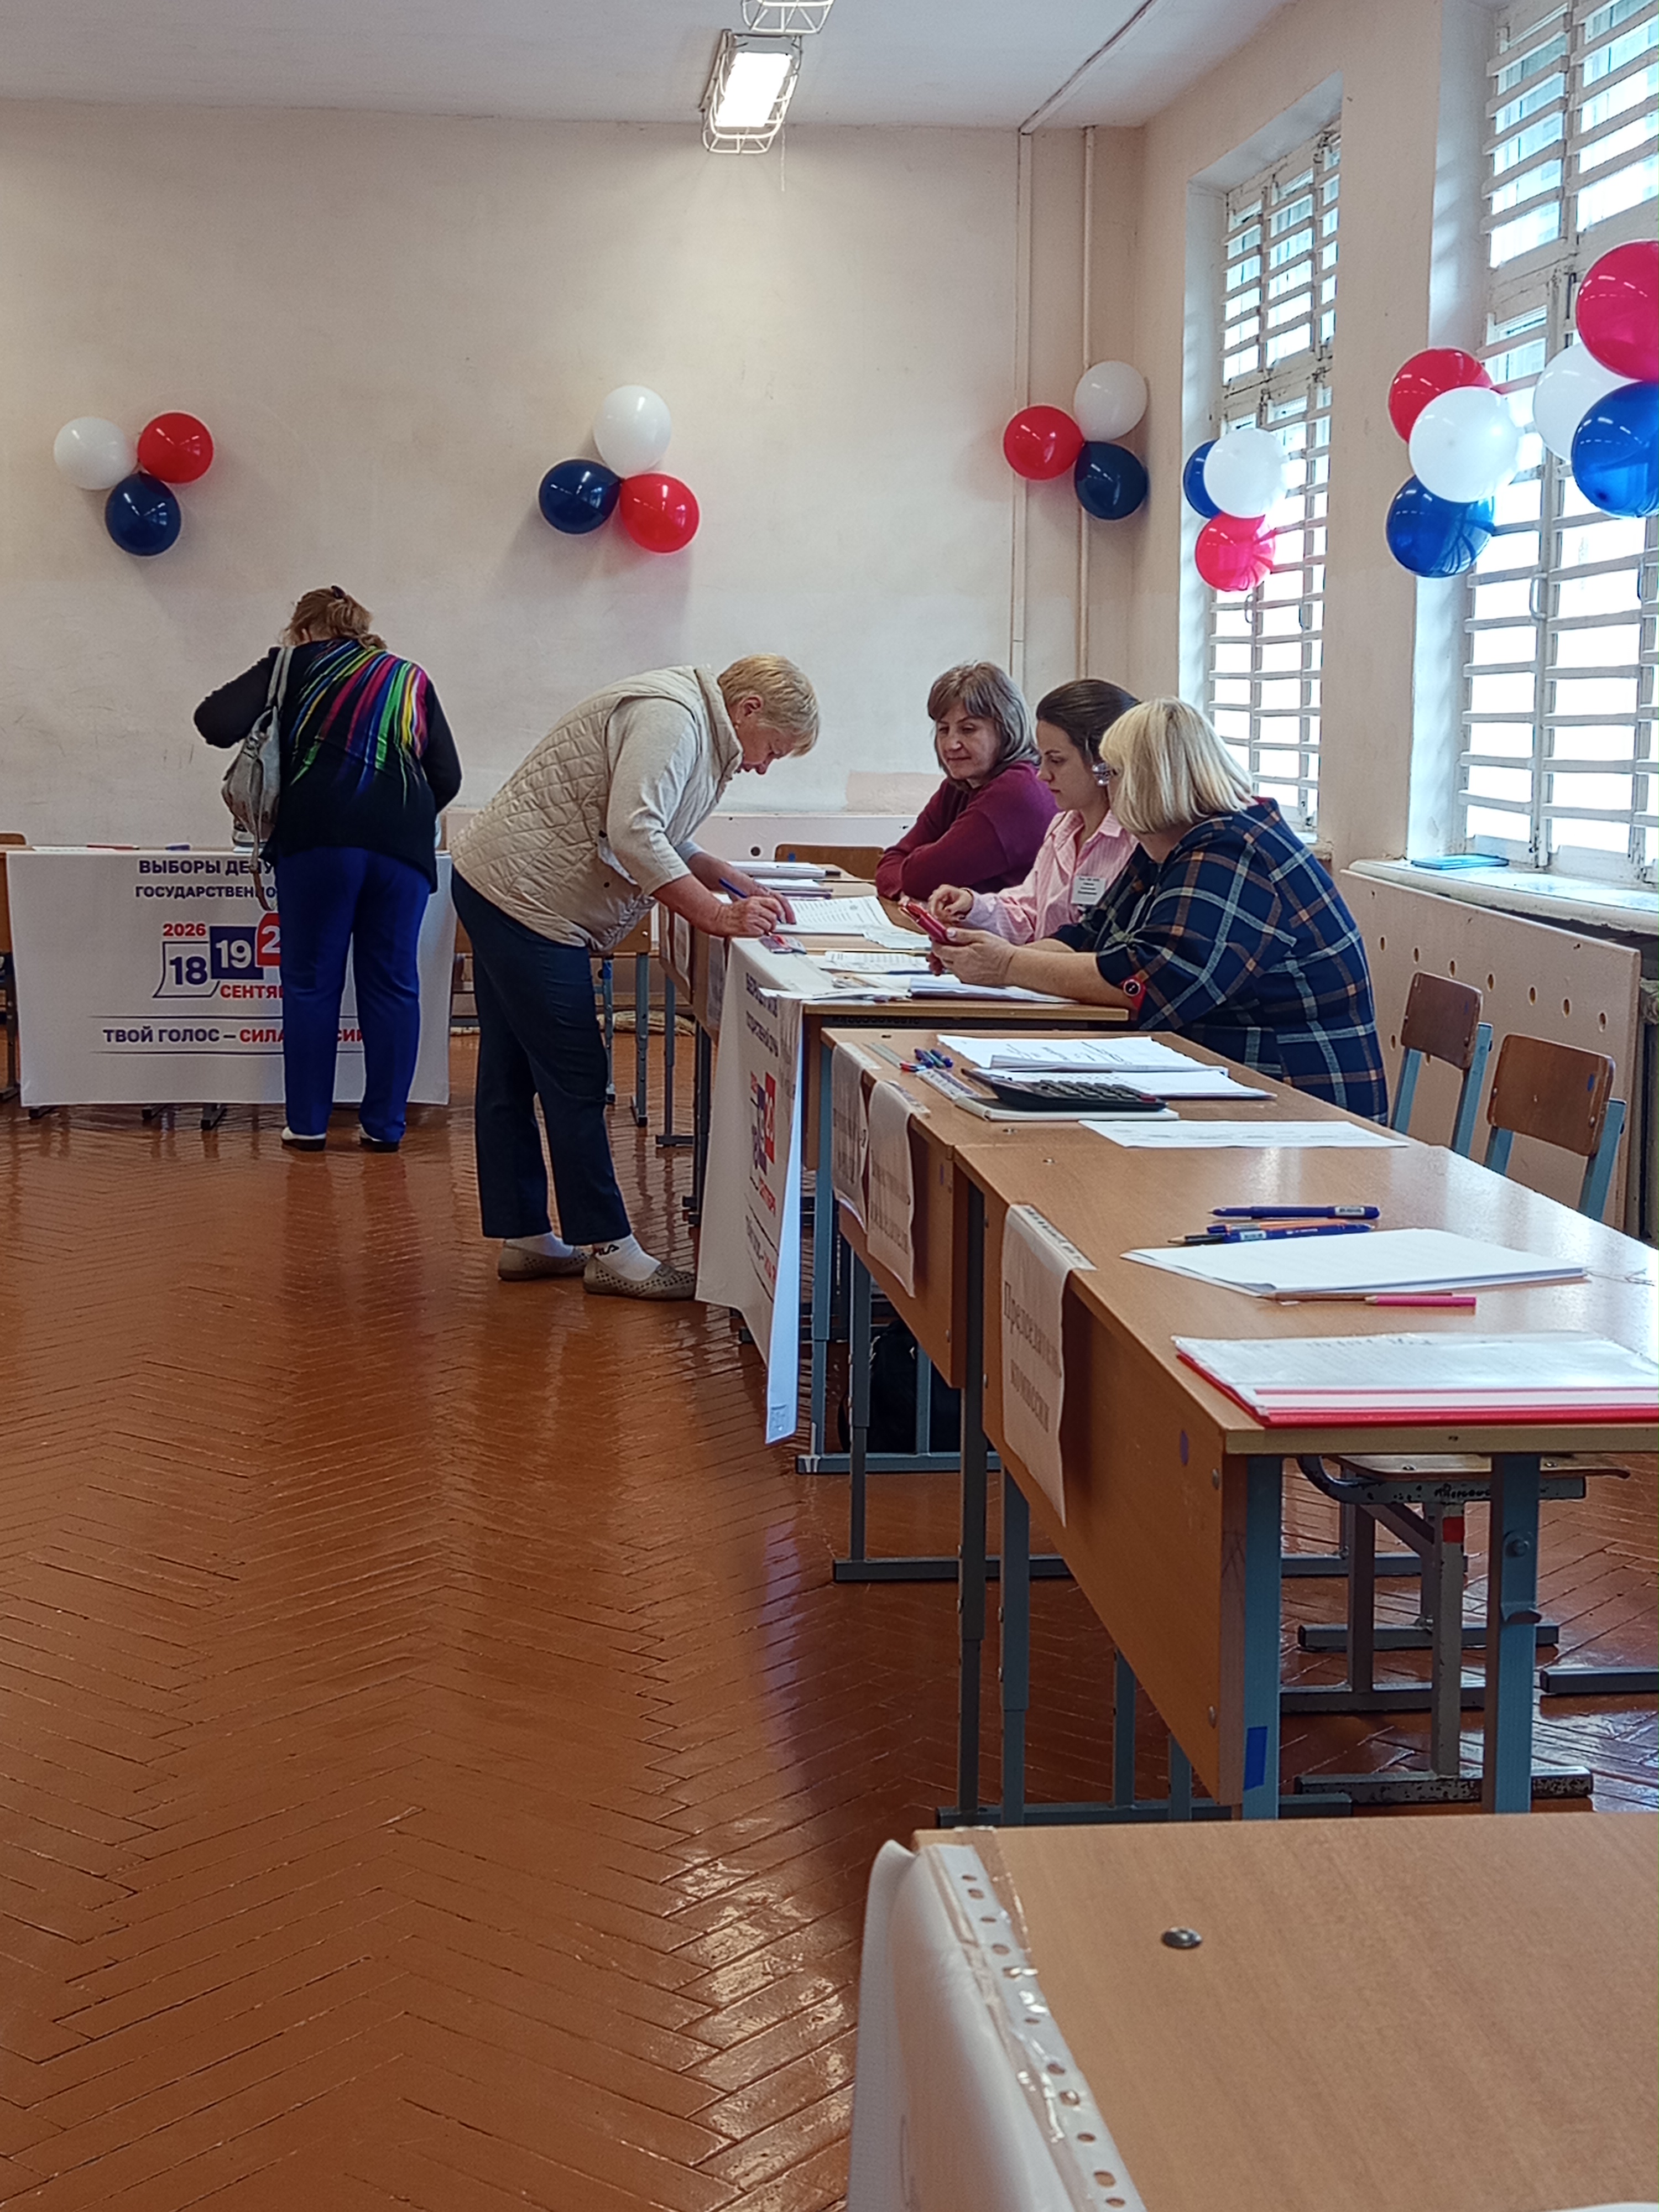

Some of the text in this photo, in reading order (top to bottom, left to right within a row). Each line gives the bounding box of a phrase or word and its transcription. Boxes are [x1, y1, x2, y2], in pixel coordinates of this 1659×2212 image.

[139, 860, 221, 874] ВЫБОРЫ
[163, 923, 206, 937] 2026
[215, 940, 253, 968] 19
[169, 956, 208, 985] 18
[102, 1025, 153, 1042] ТВОЙ
[158, 1029, 220, 1042] ГОЛОС
